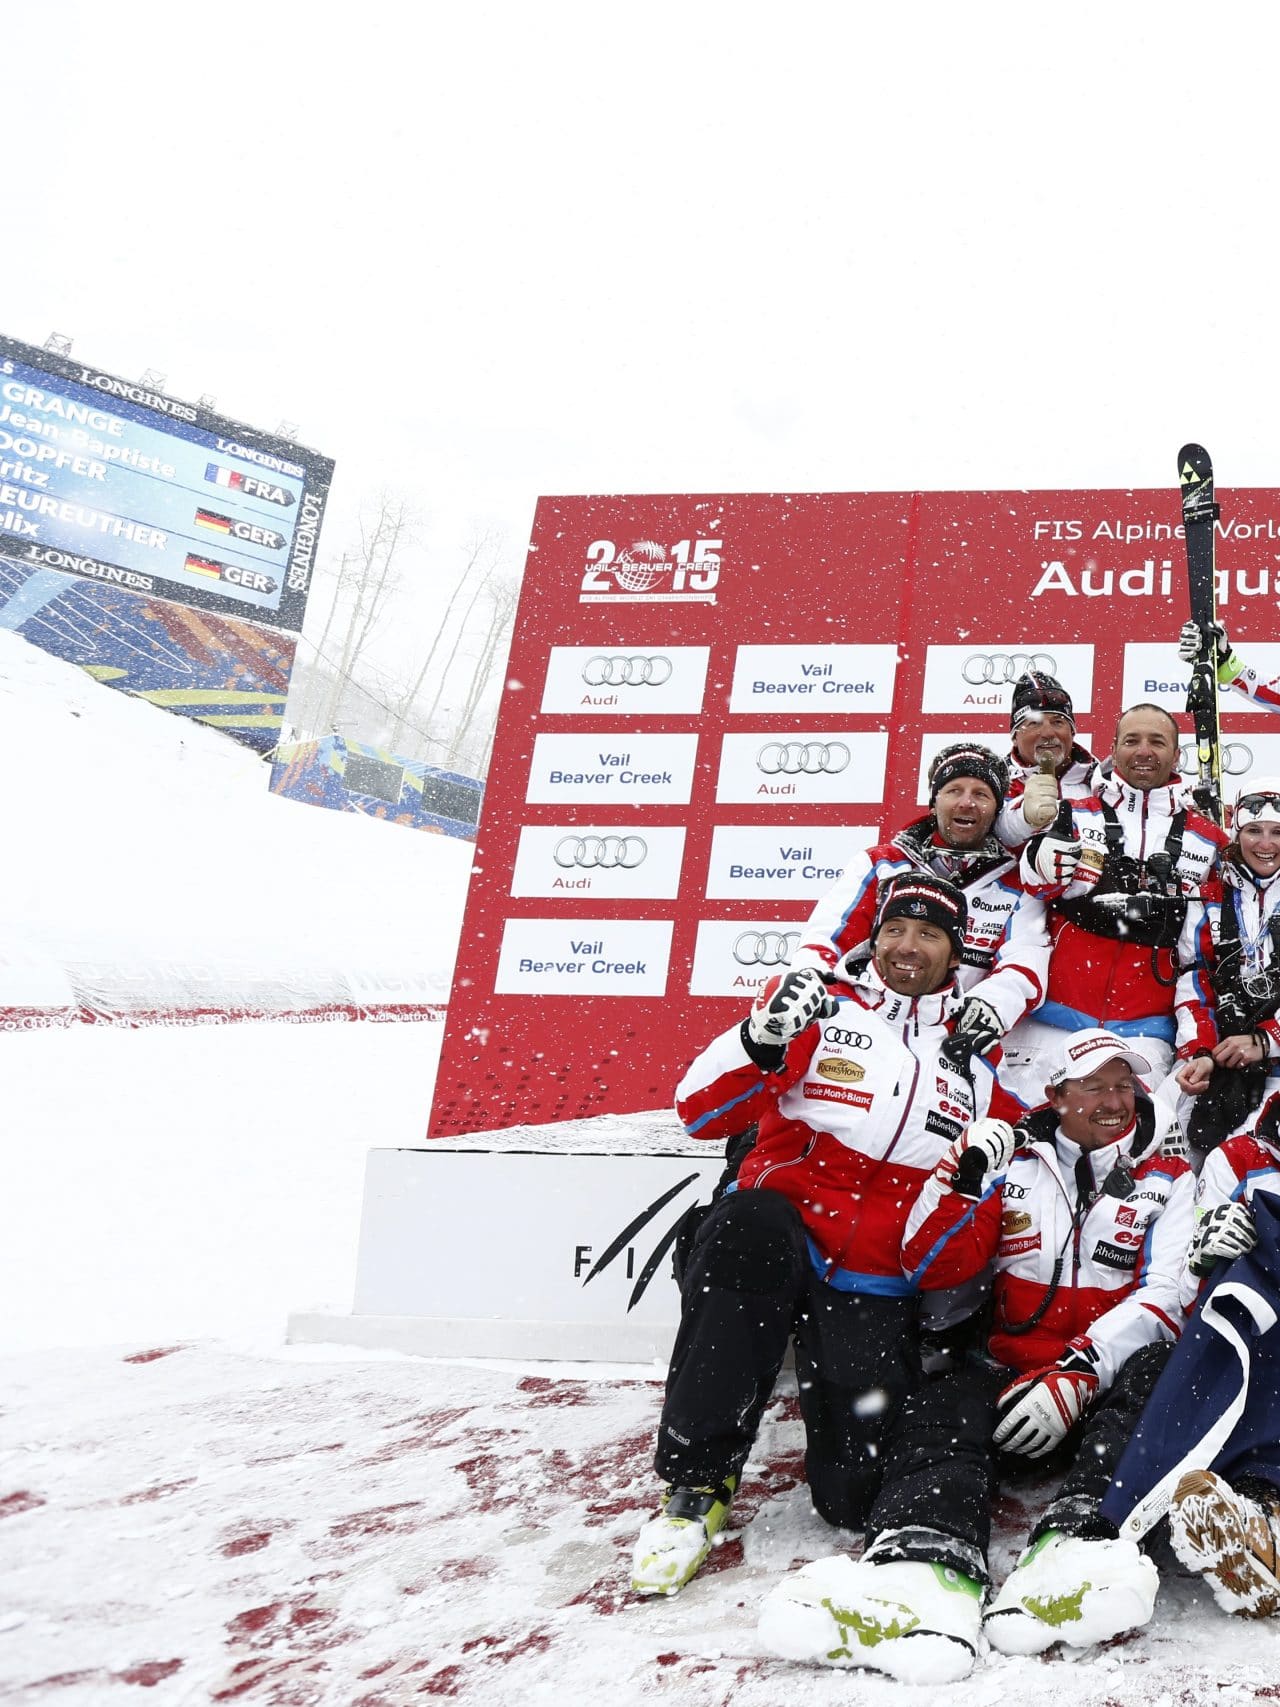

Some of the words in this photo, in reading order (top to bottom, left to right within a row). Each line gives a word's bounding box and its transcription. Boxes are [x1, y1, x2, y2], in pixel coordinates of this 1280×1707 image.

[80, 370, 198, 422] LONGINES
[3, 382, 127, 438] GRANGE
[216, 438, 305, 478] LONGINES
[0, 458, 50, 487] ritz
[242, 480, 286, 505] FRA
[0, 486, 168, 550] EUREUTHER
[233, 523, 277, 548] GER
[1034, 521, 1083, 540] FIS
[1092, 520, 1186, 544] Alpine
[289, 492, 322, 592] LONGINES
[28, 546, 153, 590] LONGINES
[621, 563, 673, 572] BEAVER
[677, 562, 721, 572] CREEK
[225, 568, 268, 592] GER
[1031, 560, 1172, 596] Audi
[801, 664, 833, 677] Vail
[752, 682, 816, 694] Beaver
[822, 681, 875, 694] Creek
[1144, 680, 1190, 692] Beav
[580, 695, 618, 706] Audi
[963, 694, 1003, 705] Audi
[598, 753, 631, 766] Vail
[550, 771, 613, 784] Beaver
[619, 771, 672, 784] Creek
[757, 783, 796, 795] Audi
[780, 848, 812, 861] Vail
[1181, 850, 1209, 864] COLMAR
[729, 866, 796, 879] Beaver
[802, 866, 845, 879] Cree
[552, 877, 592, 889] Audi
[980, 902, 1012, 912] COLMAR
[982, 922, 1004, 930] CAISSE
[570, 941, 603, 955] Vail
[519, 960, 586, 973] Beaver
[591, 960, 647, 974] Creek
[733, 976, 768, 988] Aud
[823, 1046, 842, 1054] Audi
[1070, 1042, 1097, 1058] Savoie
[847, 1093, 872, 1105] Blanc
